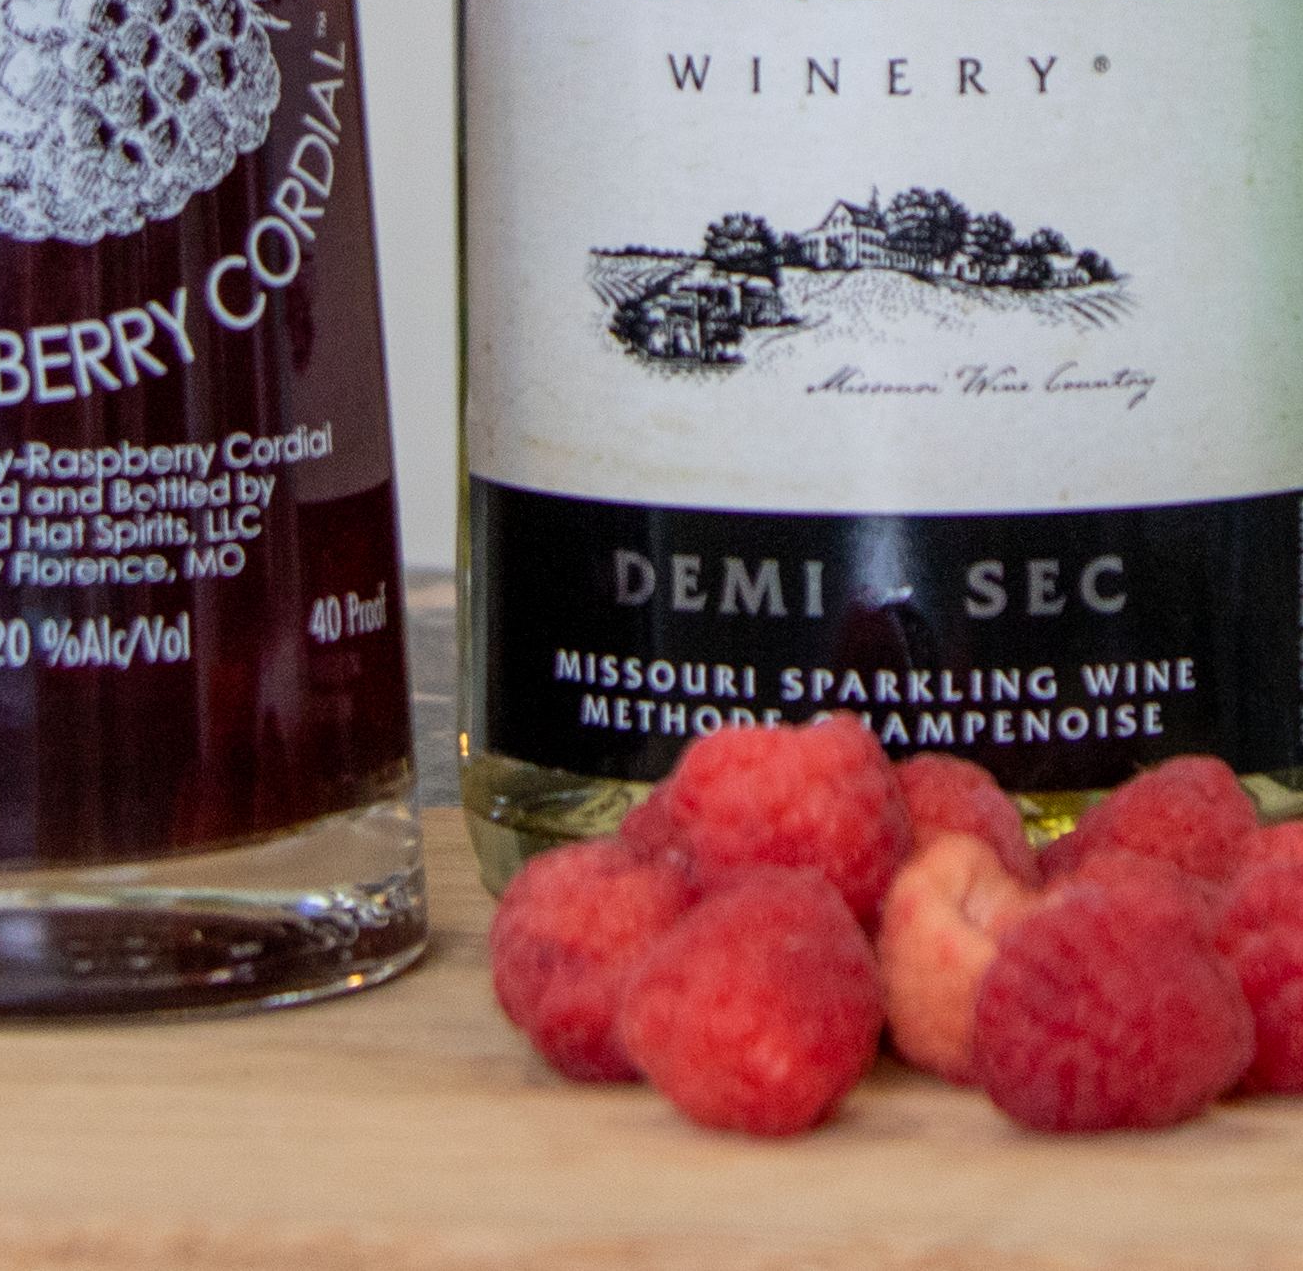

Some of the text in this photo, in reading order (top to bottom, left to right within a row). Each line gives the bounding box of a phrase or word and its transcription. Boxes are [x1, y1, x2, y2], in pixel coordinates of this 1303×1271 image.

[667, 53, 1059, 98] WINERY
[204, 41, 346, 331] CORDIAL
[802, 359, 1158, 411] Missouri Wine Country
[222, 420, 333, 470] Cordial
[26, 479, 104, 515] and
[108, 471, 232, 514] Bottled
[235, 470, 276, 509] by
[18, 514, 85, 551] Hat
[94, 511, 197, 555] Spirits,
[204, 504, 263, 544] LLC
[10, 549, 177, 587] Florence,
[182, 541, 246, 581] MO
[614, 550, 826, 619] DEMI
[963, 553, 1128, 620] SEC
[307, 593, 342, 645] 40
[555, 648, 1197, 705] MISSOURI SPARKLING WINE
